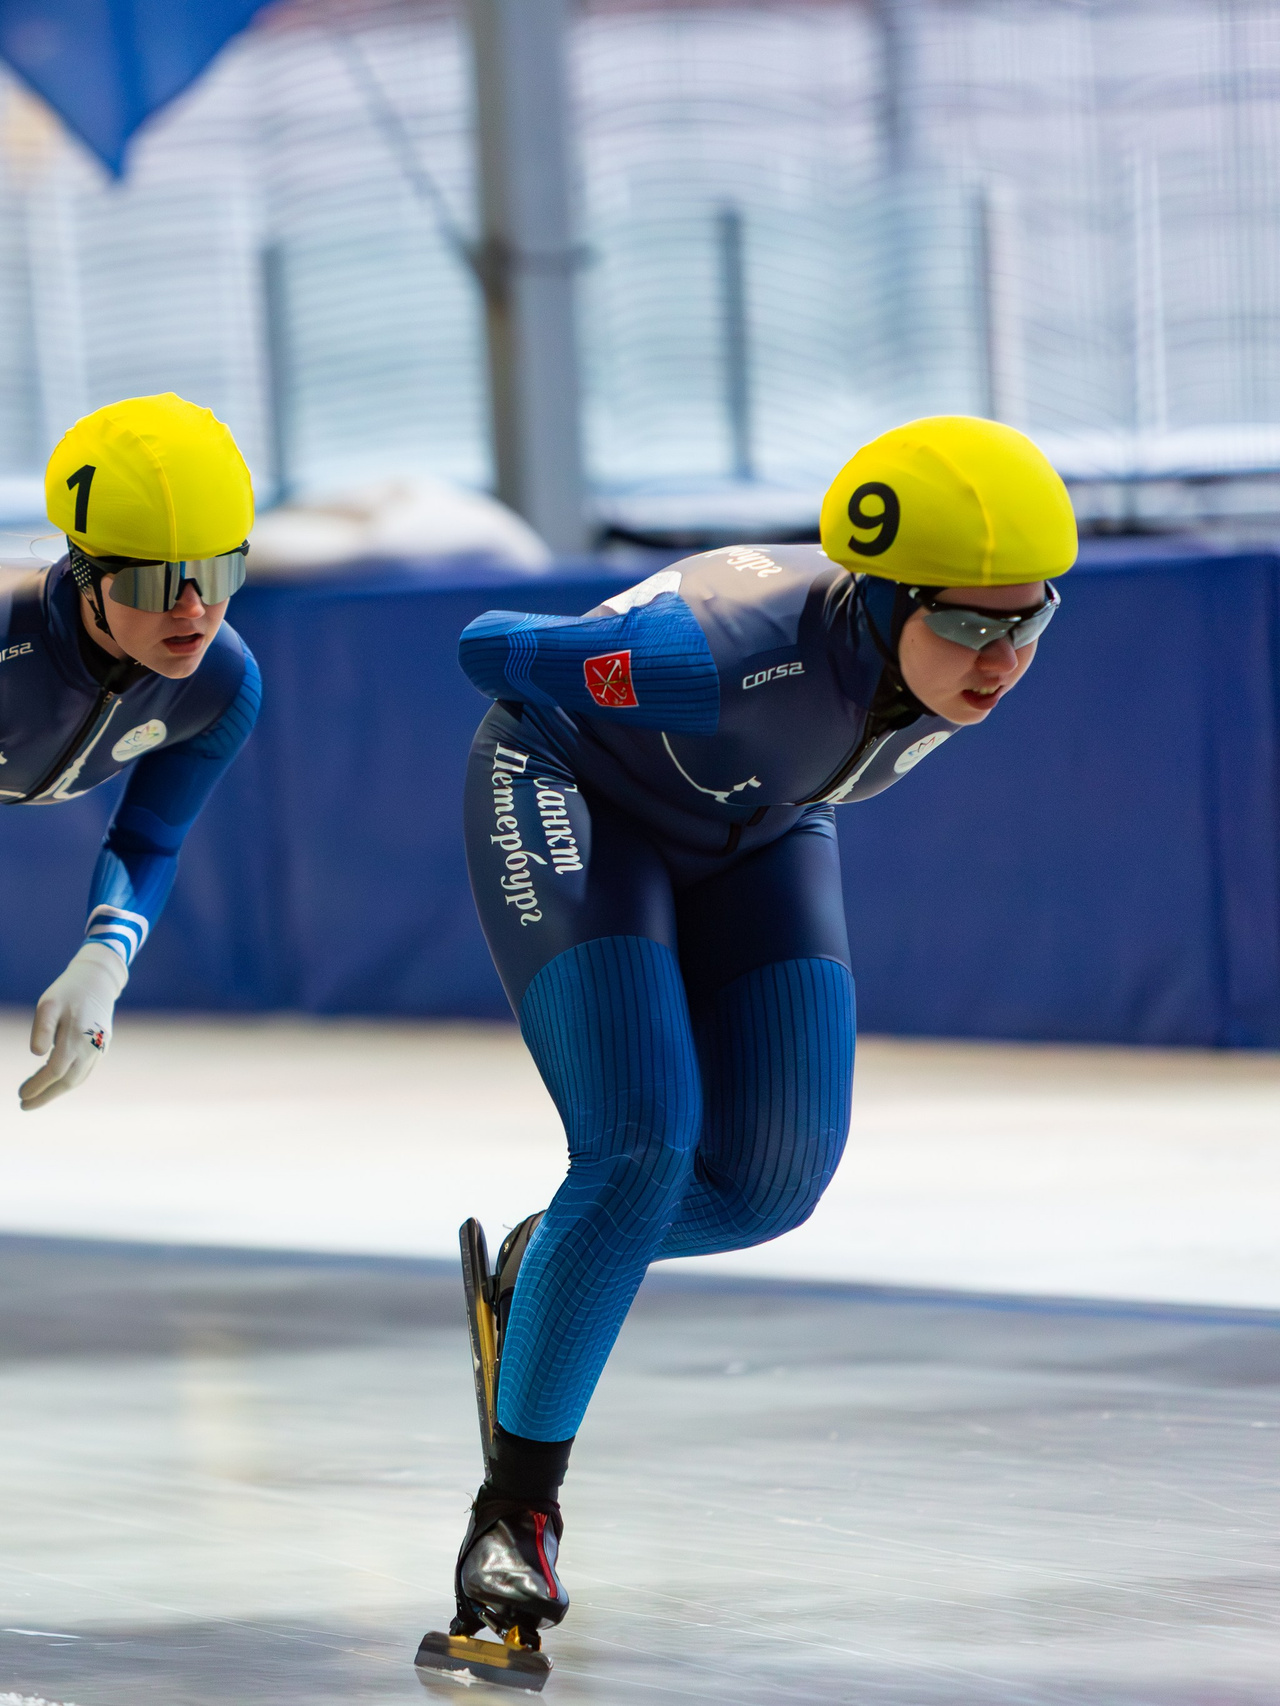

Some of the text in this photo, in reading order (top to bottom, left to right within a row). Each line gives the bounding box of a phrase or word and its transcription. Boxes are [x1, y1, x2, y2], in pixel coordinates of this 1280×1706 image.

[66, 464, 97, 534] 1
[847, 481, 901, 557] 9
[742, 661, 806, 690] corsa
[490, 742, 548, 927] Петербург
[533, 776, 584, 875] Санкт
